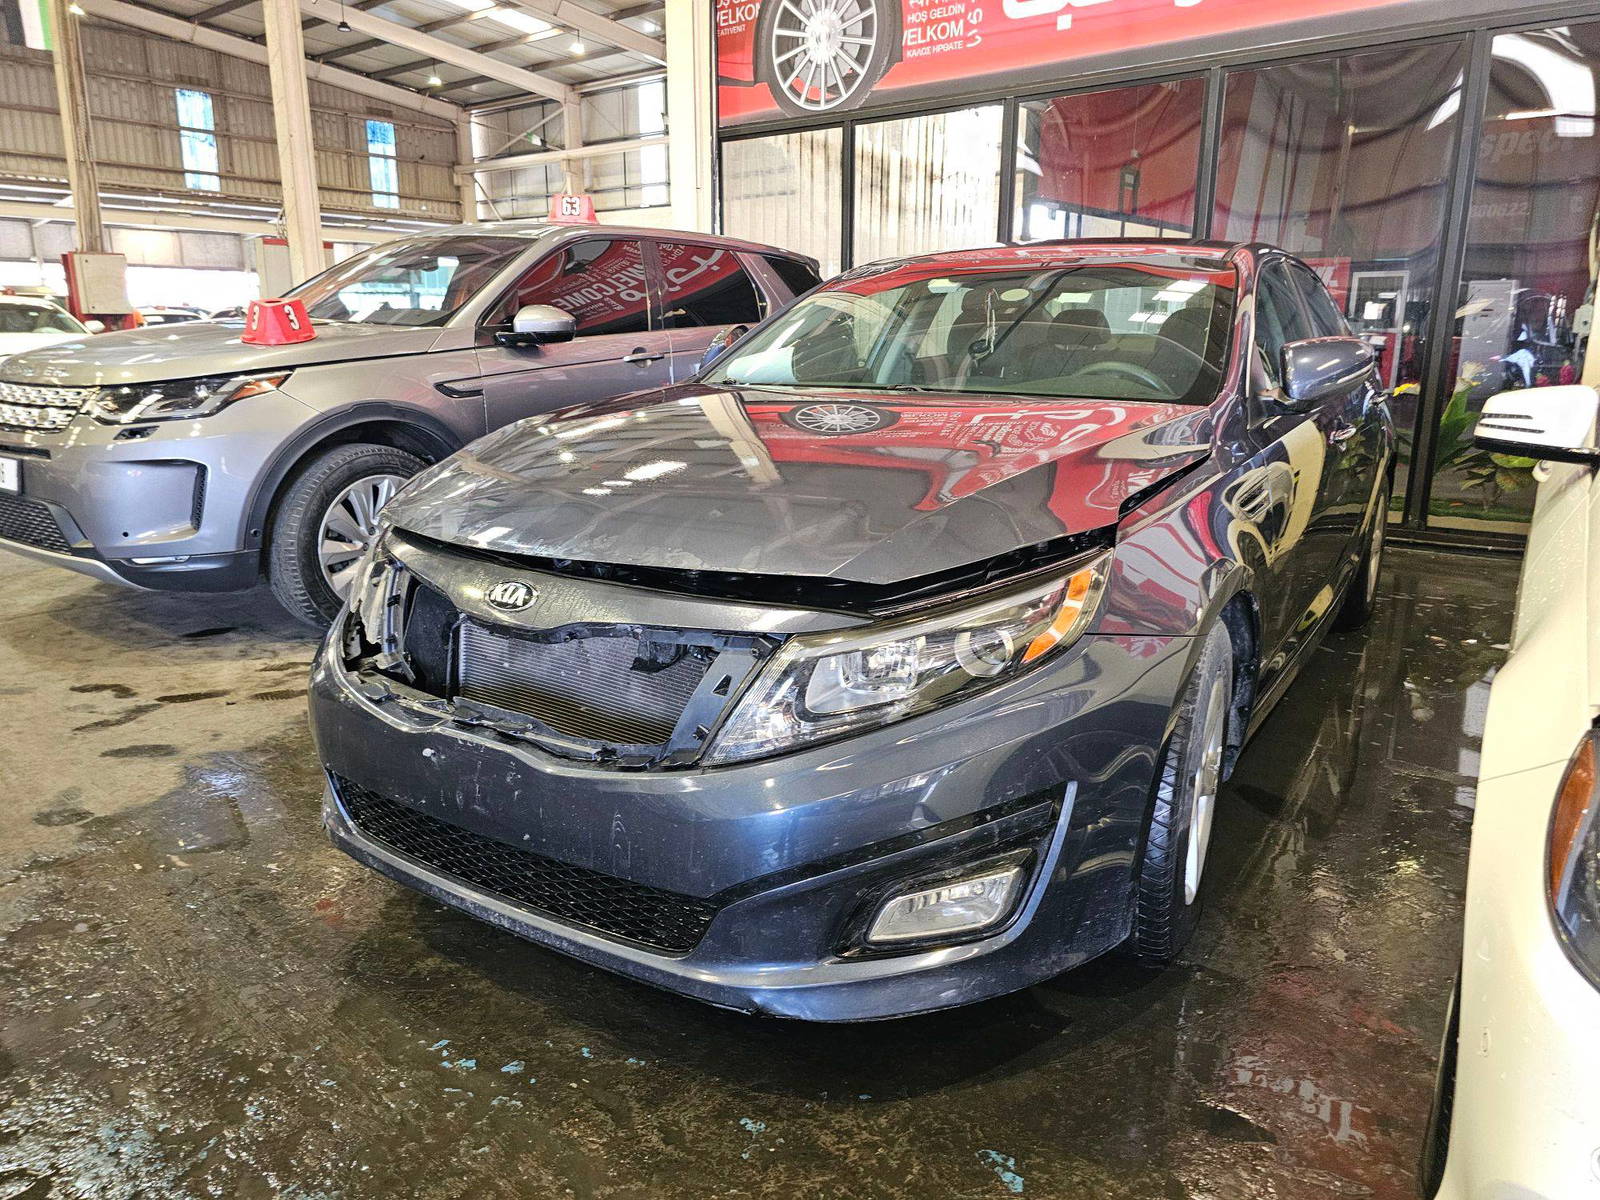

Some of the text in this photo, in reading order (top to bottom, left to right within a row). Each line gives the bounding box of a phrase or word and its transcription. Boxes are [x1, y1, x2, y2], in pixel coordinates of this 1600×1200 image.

[717, 2, 760, 26] ELKO
[902, 19, 963, 46] ELKOM
[562, 196, 580, 216] 63
[490, 583, 527, 606] KIA
